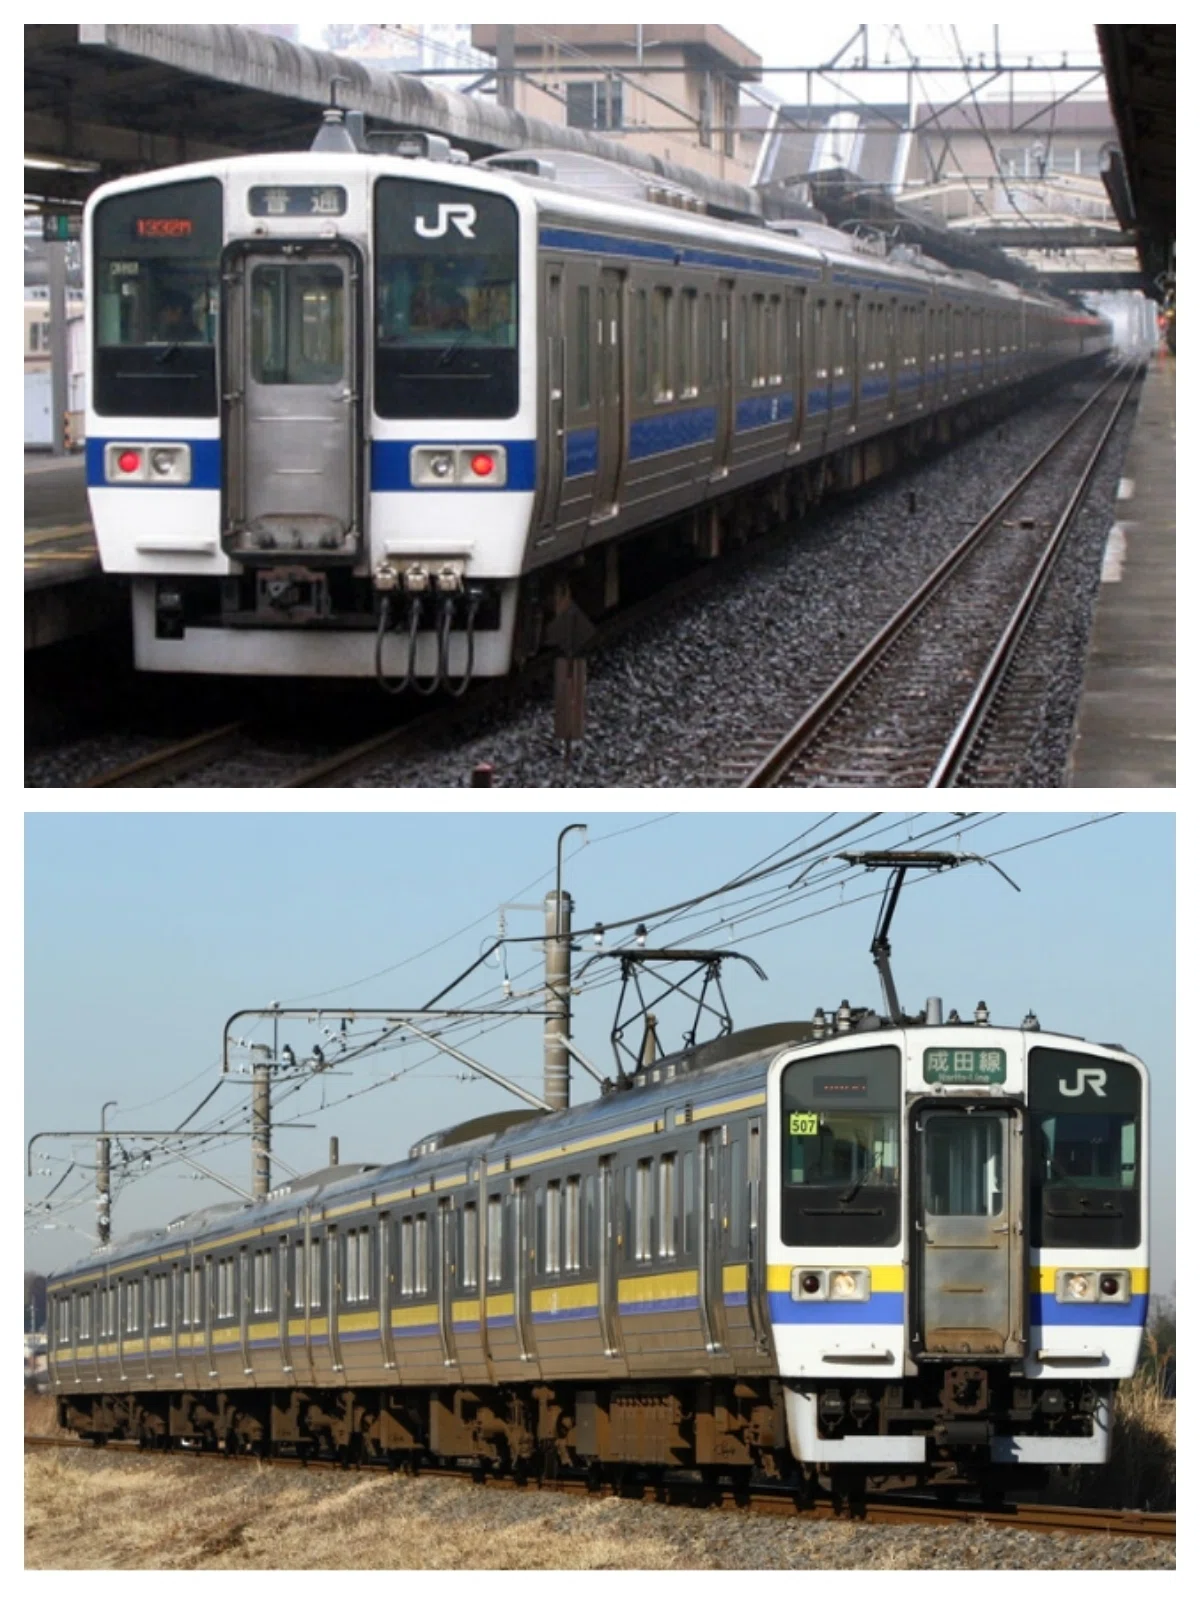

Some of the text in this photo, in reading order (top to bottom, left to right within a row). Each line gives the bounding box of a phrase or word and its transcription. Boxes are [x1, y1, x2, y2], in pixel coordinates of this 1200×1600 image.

[262, 187, 340, 215] 普通
[415, 203, 477, 239] JR
[927, 1049, 1001, 1072] 成田線
[1059, 1068, 1107, 1097] JR
[792, 1119, 816, 1132] 507
